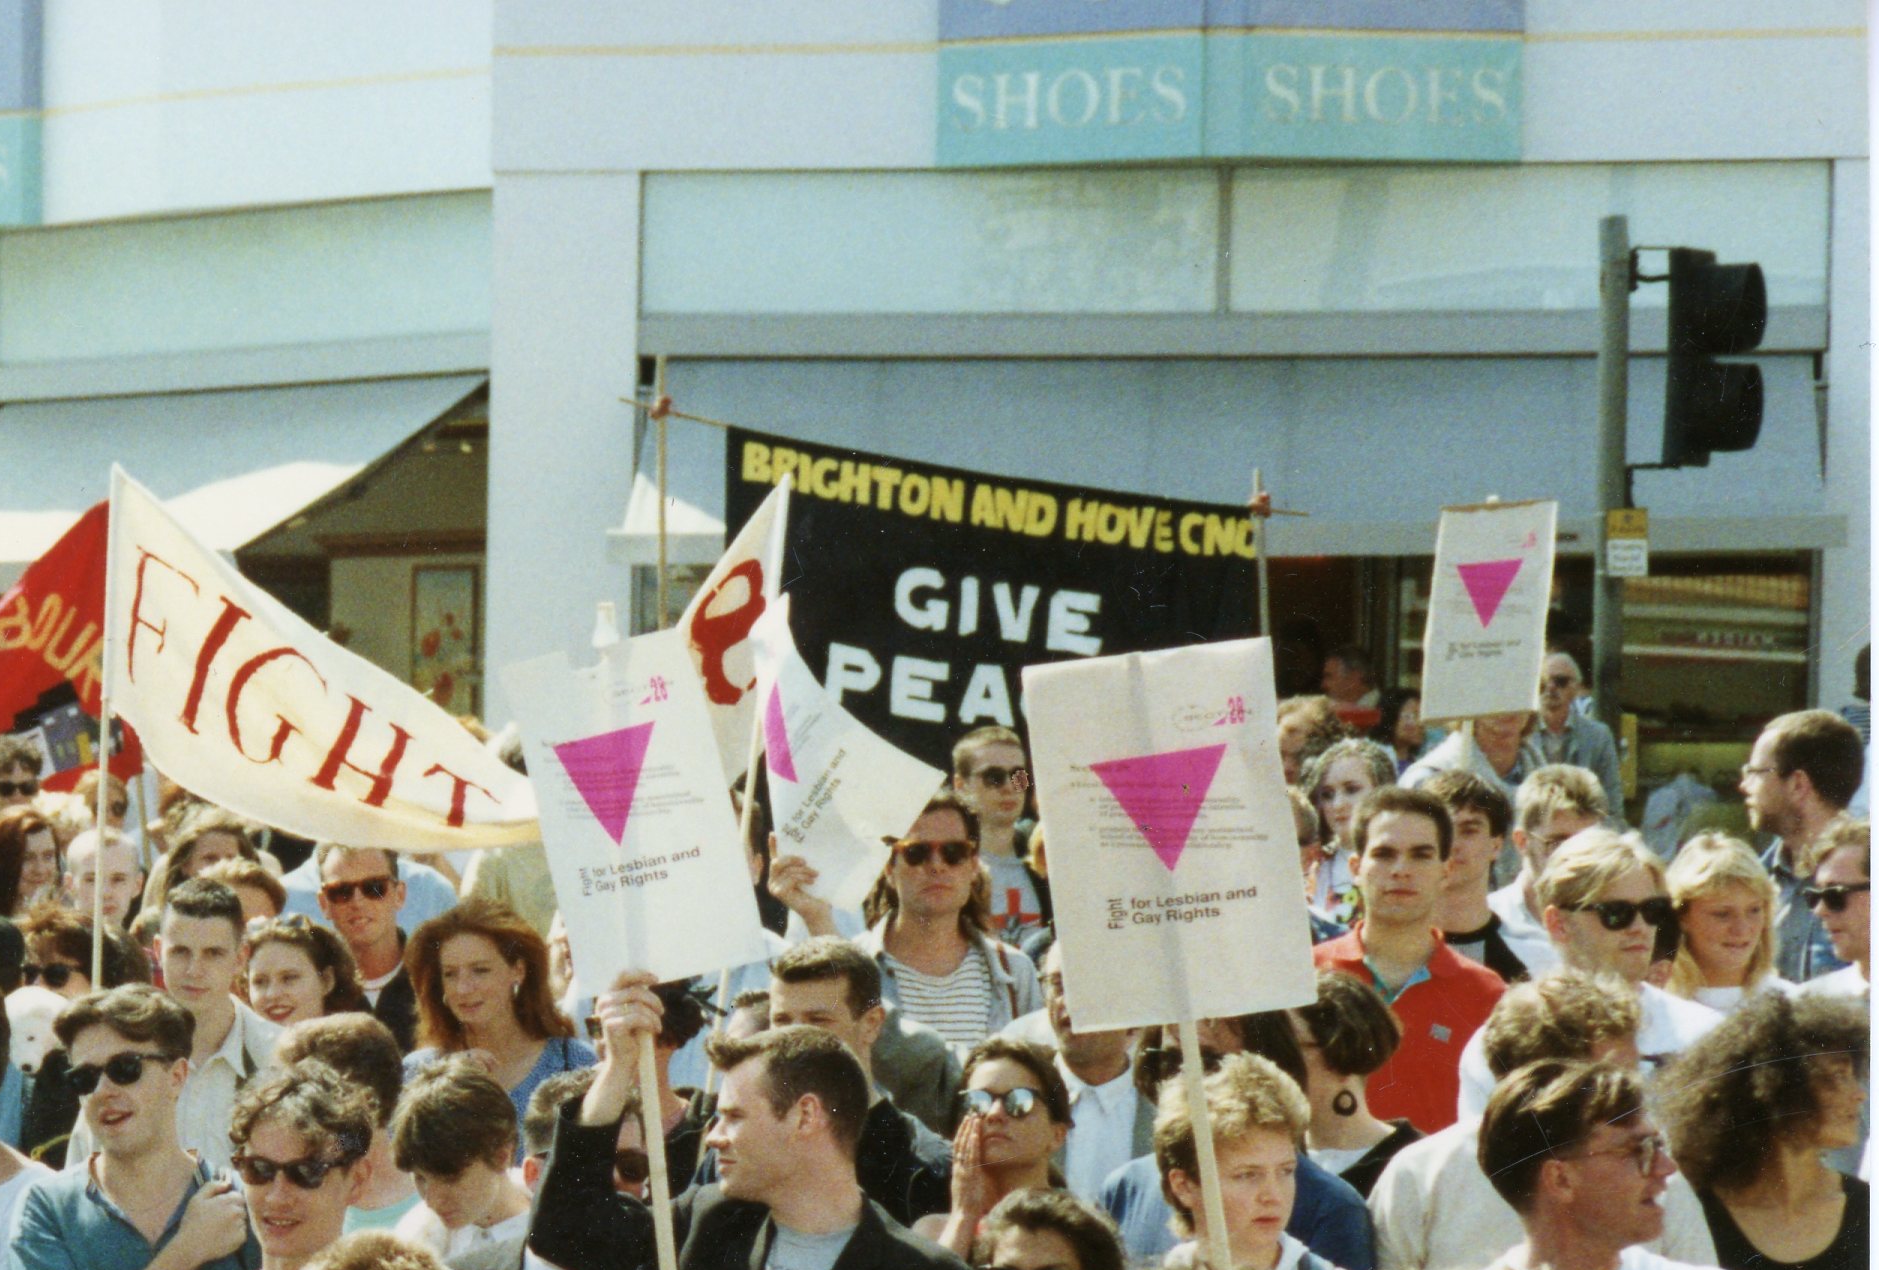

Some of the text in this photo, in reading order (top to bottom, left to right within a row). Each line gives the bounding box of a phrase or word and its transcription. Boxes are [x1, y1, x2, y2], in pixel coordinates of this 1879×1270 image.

[951, 65, 1187, 132] SHOES
[1264, 64, 1507, 126] SHOES
[742, 440, 964, 523] BRIGHTON
[972, 484, 1059, 538] AND
[1064, 498, 1175, 553] HOVE
[893, 565, 1104, 656] GIVE
[127, 543, 502, 828] FIGHT
[1227, 696, 1245, 725] 28
[593, 846, 701, 877] for Lesbian and
[595, 869, 669, 893] Gay Rights
[1108, 898, 1124, 930] Fight
[1131, 886, 1258, 910] for Lesbian and
[1132, 906, 1220, 925] Gay Rights
